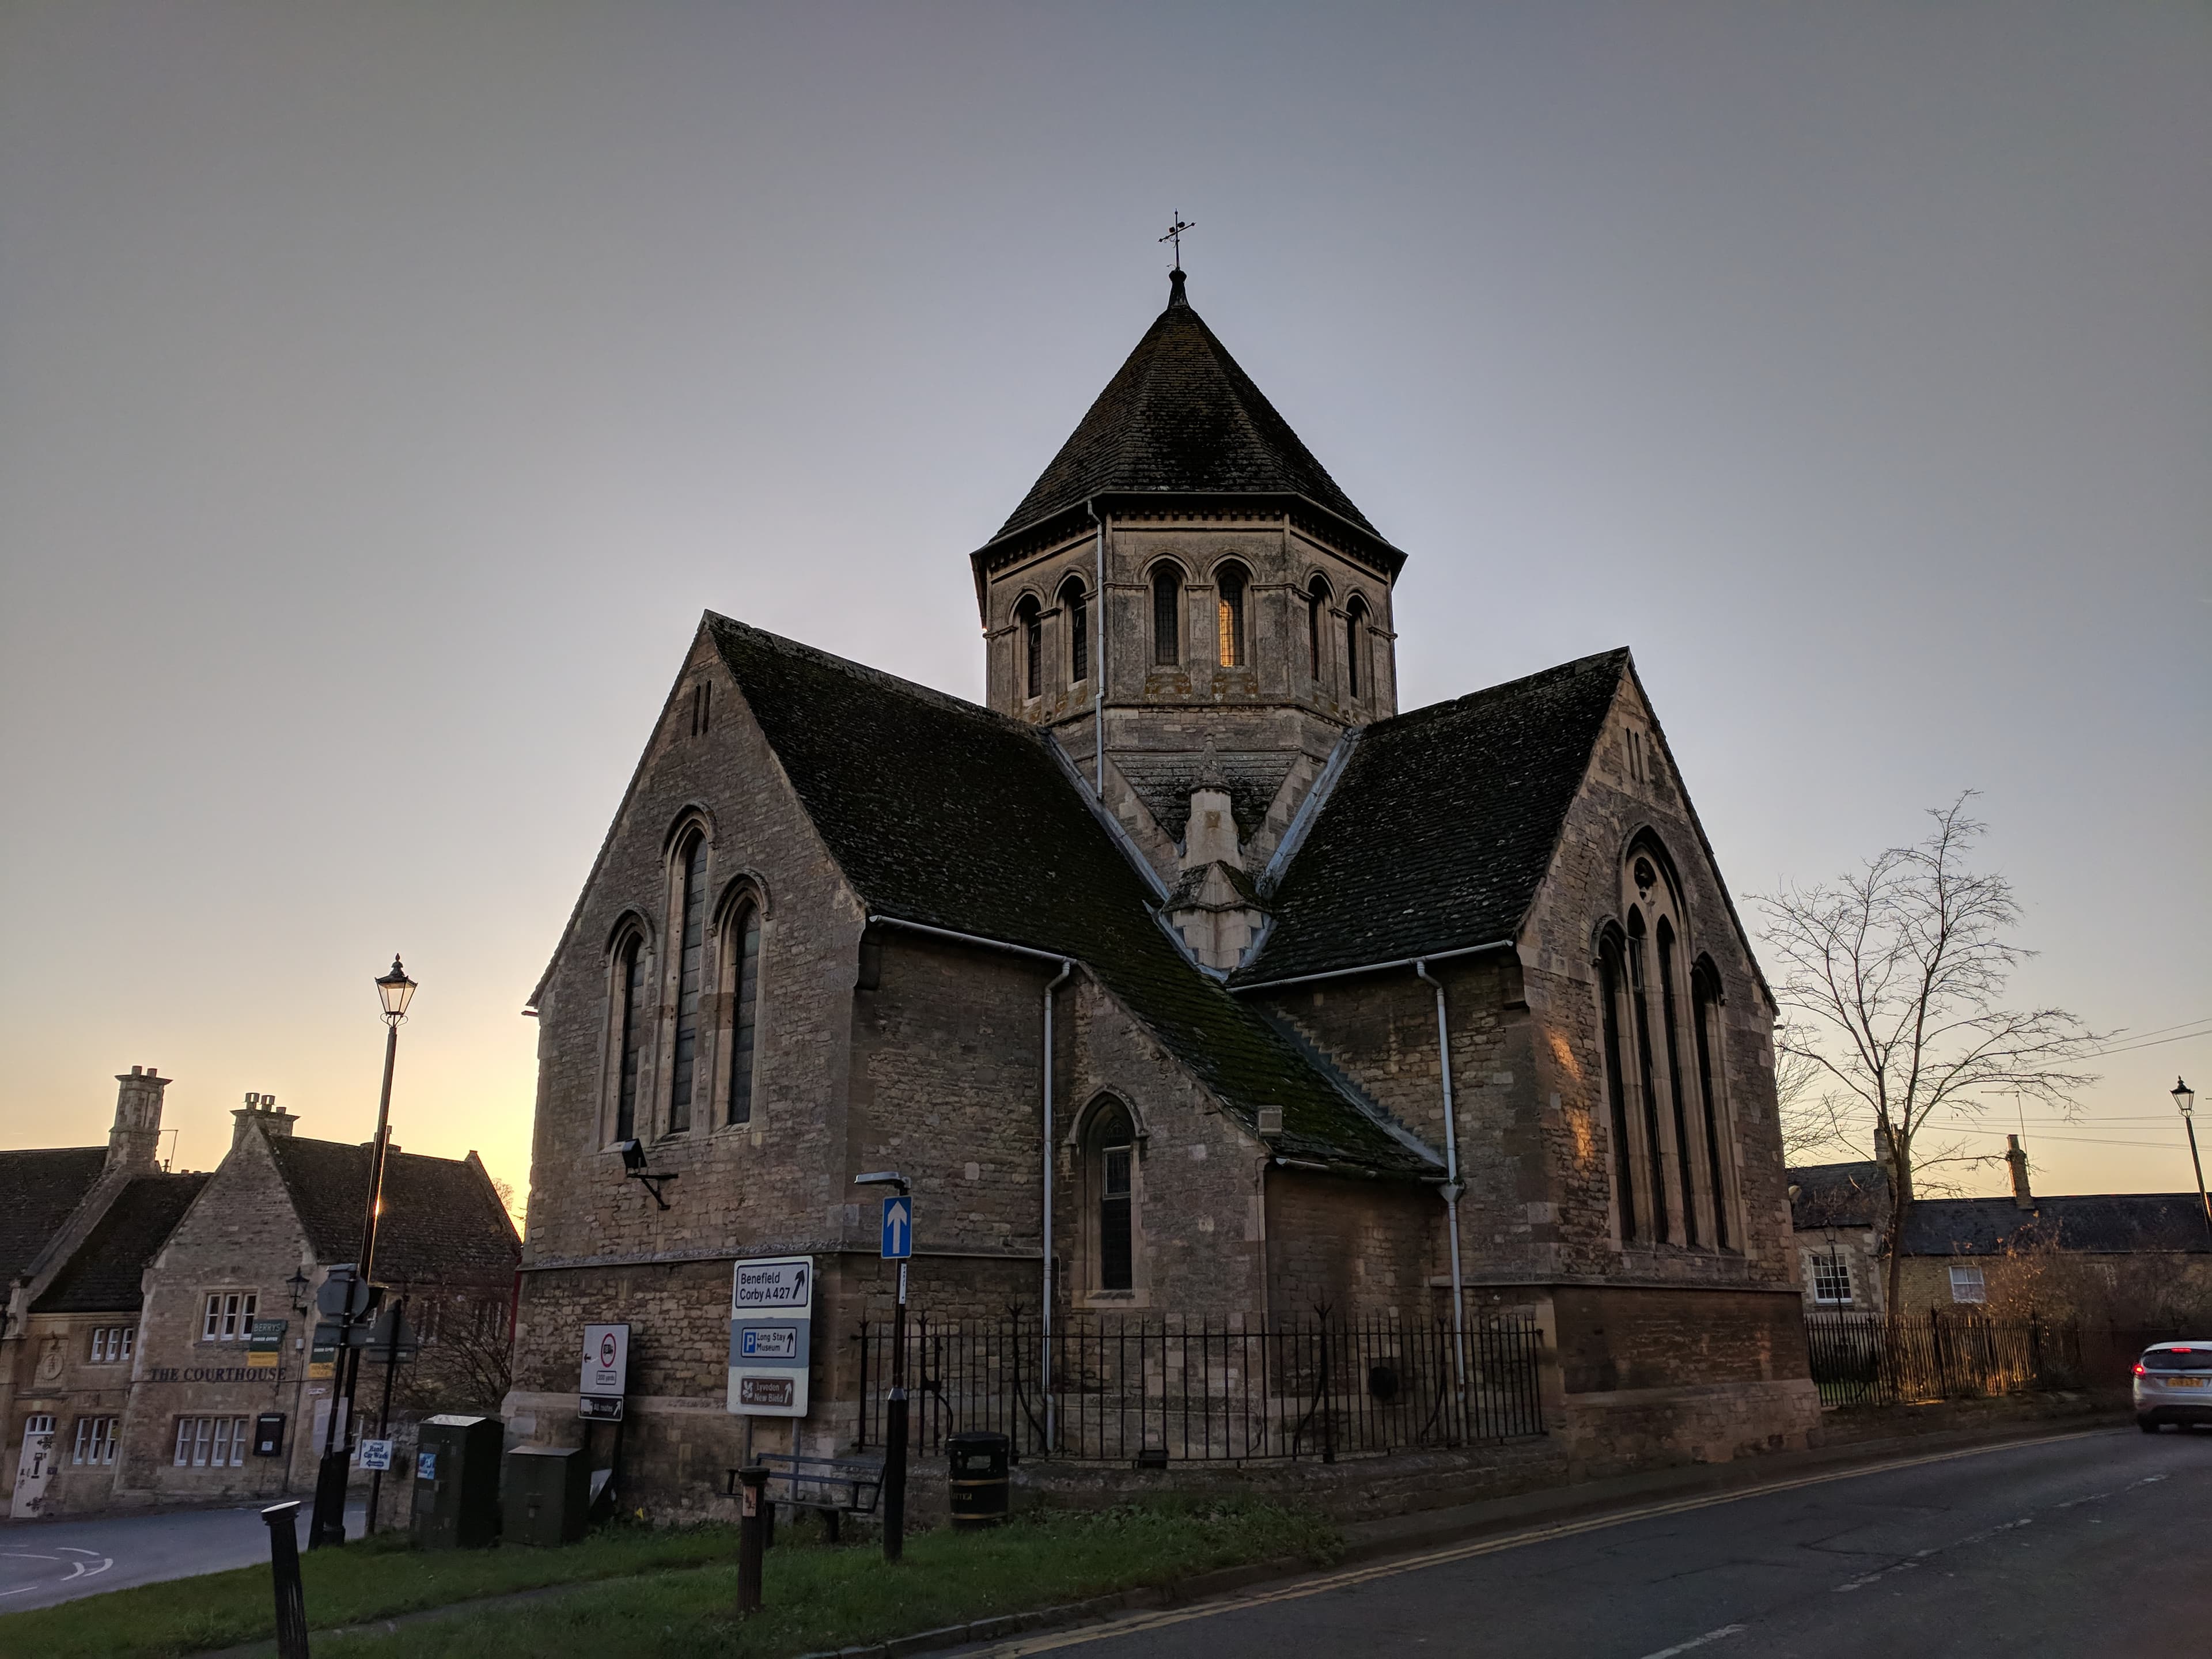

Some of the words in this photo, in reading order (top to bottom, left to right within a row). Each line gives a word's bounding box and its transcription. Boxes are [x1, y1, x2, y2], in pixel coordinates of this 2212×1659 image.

[741, 1272, 780, 1284] Benefield
[740, 1288, 764, 1302] Corby
[253, 1323, 280, 1332] BERRYS
[757, 1332, 771, 1342] Long
[772, 1332, 786, 1342] Stay
[747, 1335, 755, 1351] P
[756, 1343, 781, 1351] Museum
[151, 1368, 179, 1381] THE
[184, 1368, 287, 1381] COURTHOUSE
[754, 1393, 767, 1402] New
